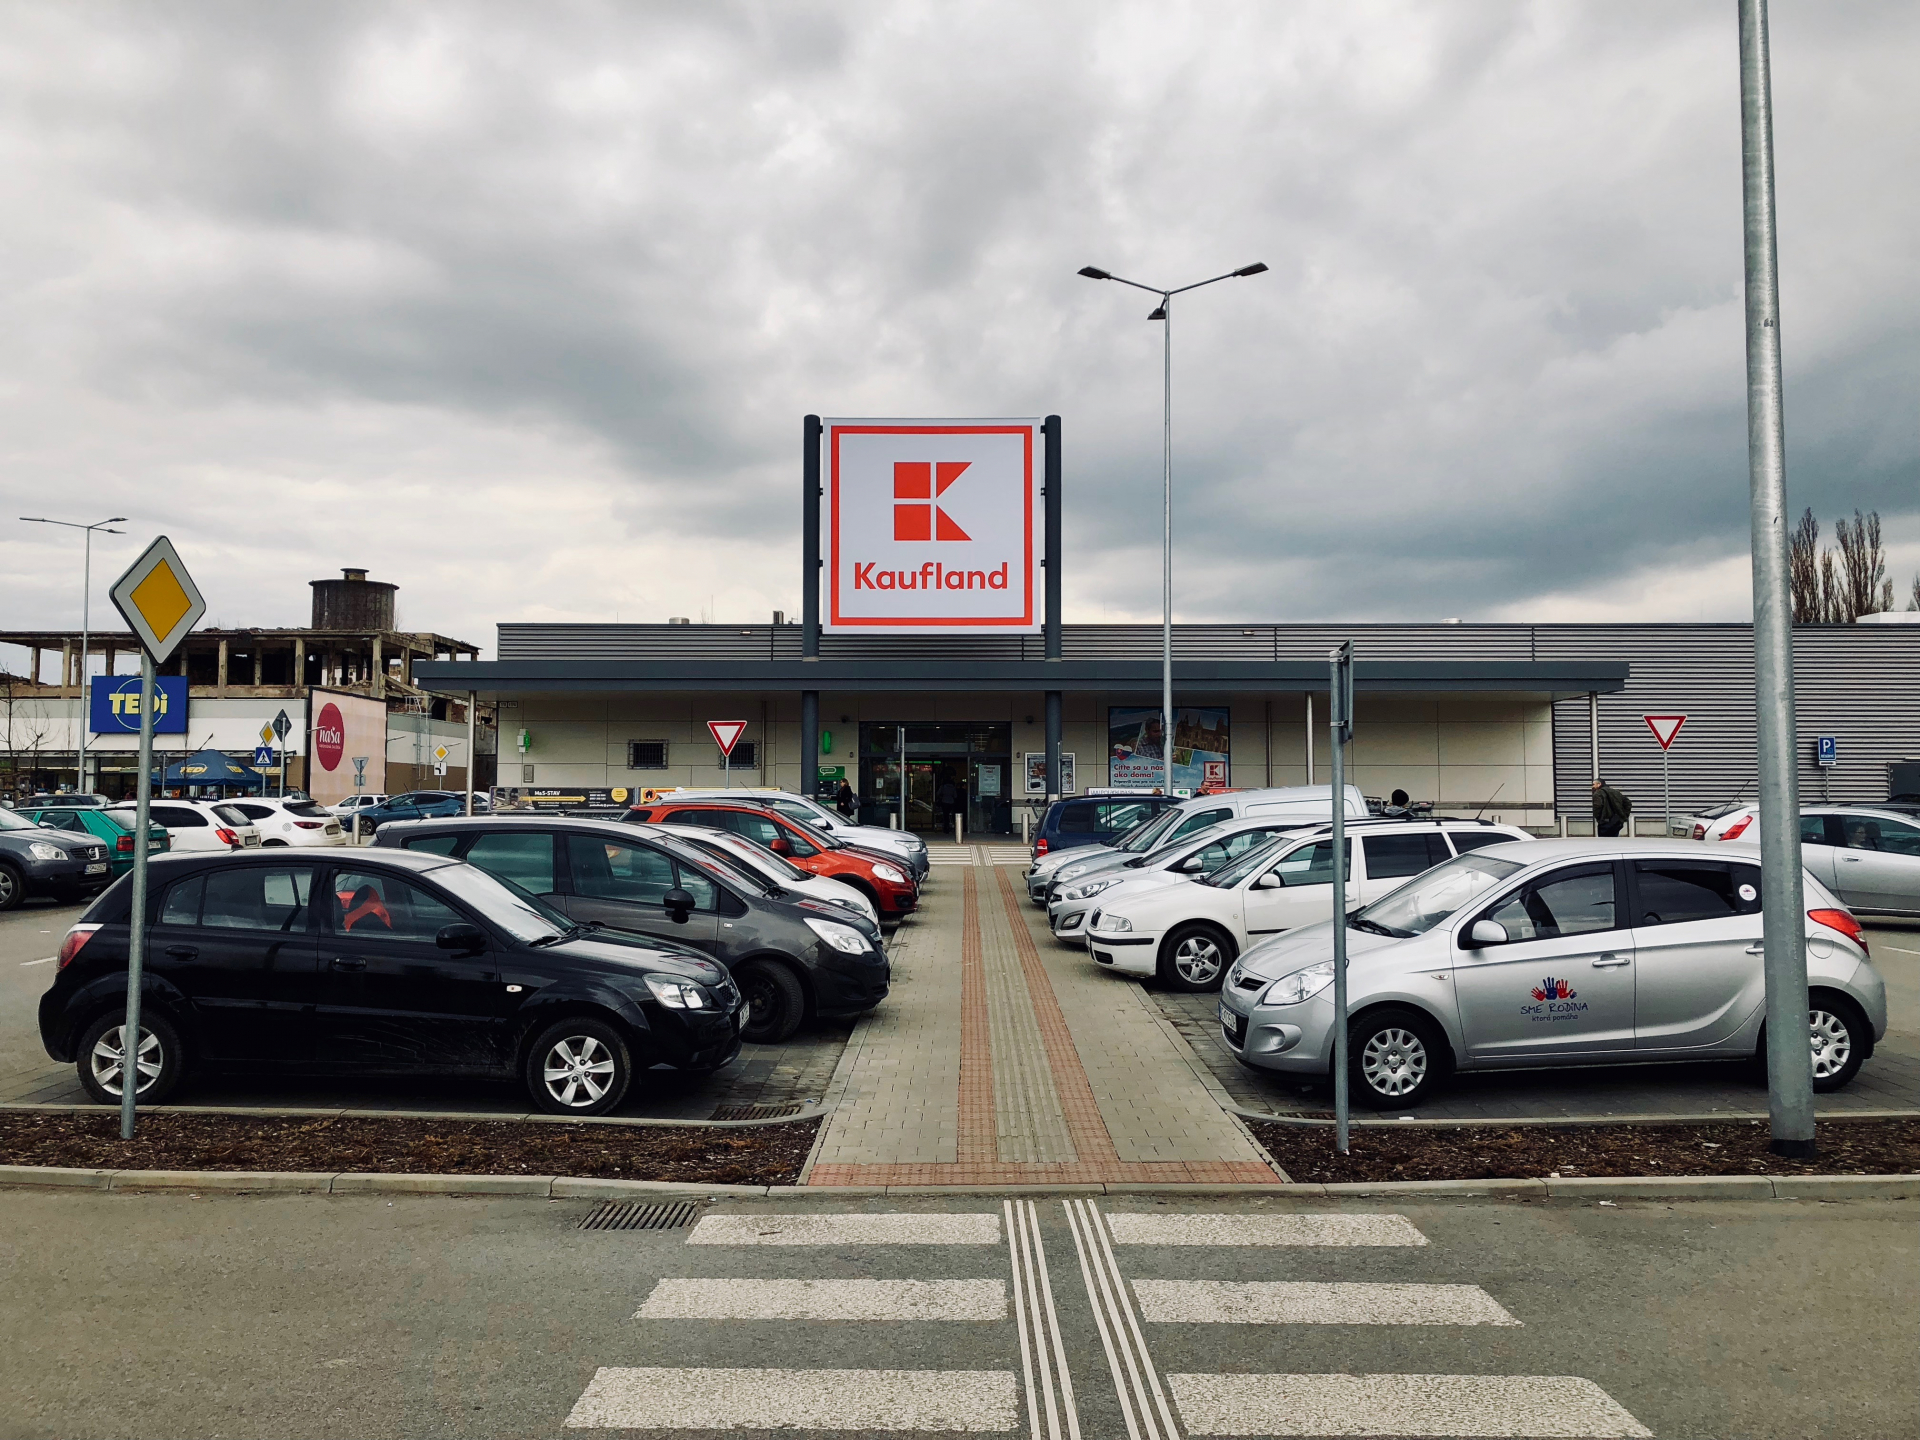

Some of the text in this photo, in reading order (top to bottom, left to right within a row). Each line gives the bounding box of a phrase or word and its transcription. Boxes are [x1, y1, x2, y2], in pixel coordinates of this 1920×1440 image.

[854, 562, 1008, 590] Kaufland
[1822, 739, 1831, 753] P
[1520, 1003, 1544, 1015] SME
[1531, 1014, 1552, 1022] ktorá
